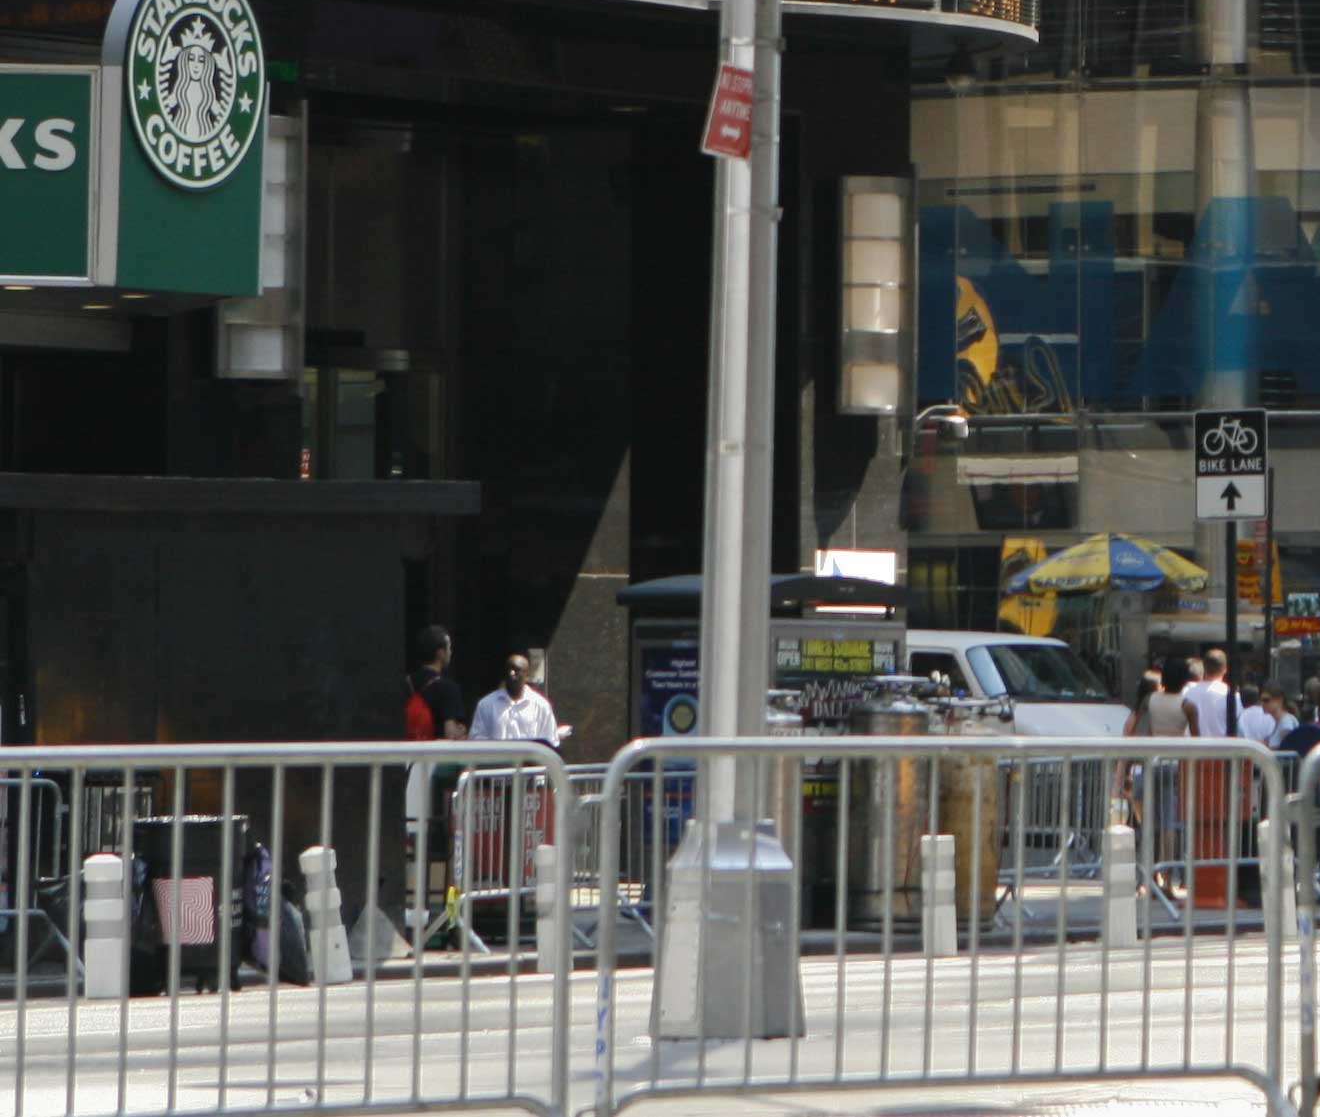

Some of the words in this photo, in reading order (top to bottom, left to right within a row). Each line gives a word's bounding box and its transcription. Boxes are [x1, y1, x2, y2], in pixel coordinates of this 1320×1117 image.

[145, 113, 241, 178] COFFEE
[1200, 459, 1226, 473] BIKE
[1231, 457, 1263, 472] LANE
